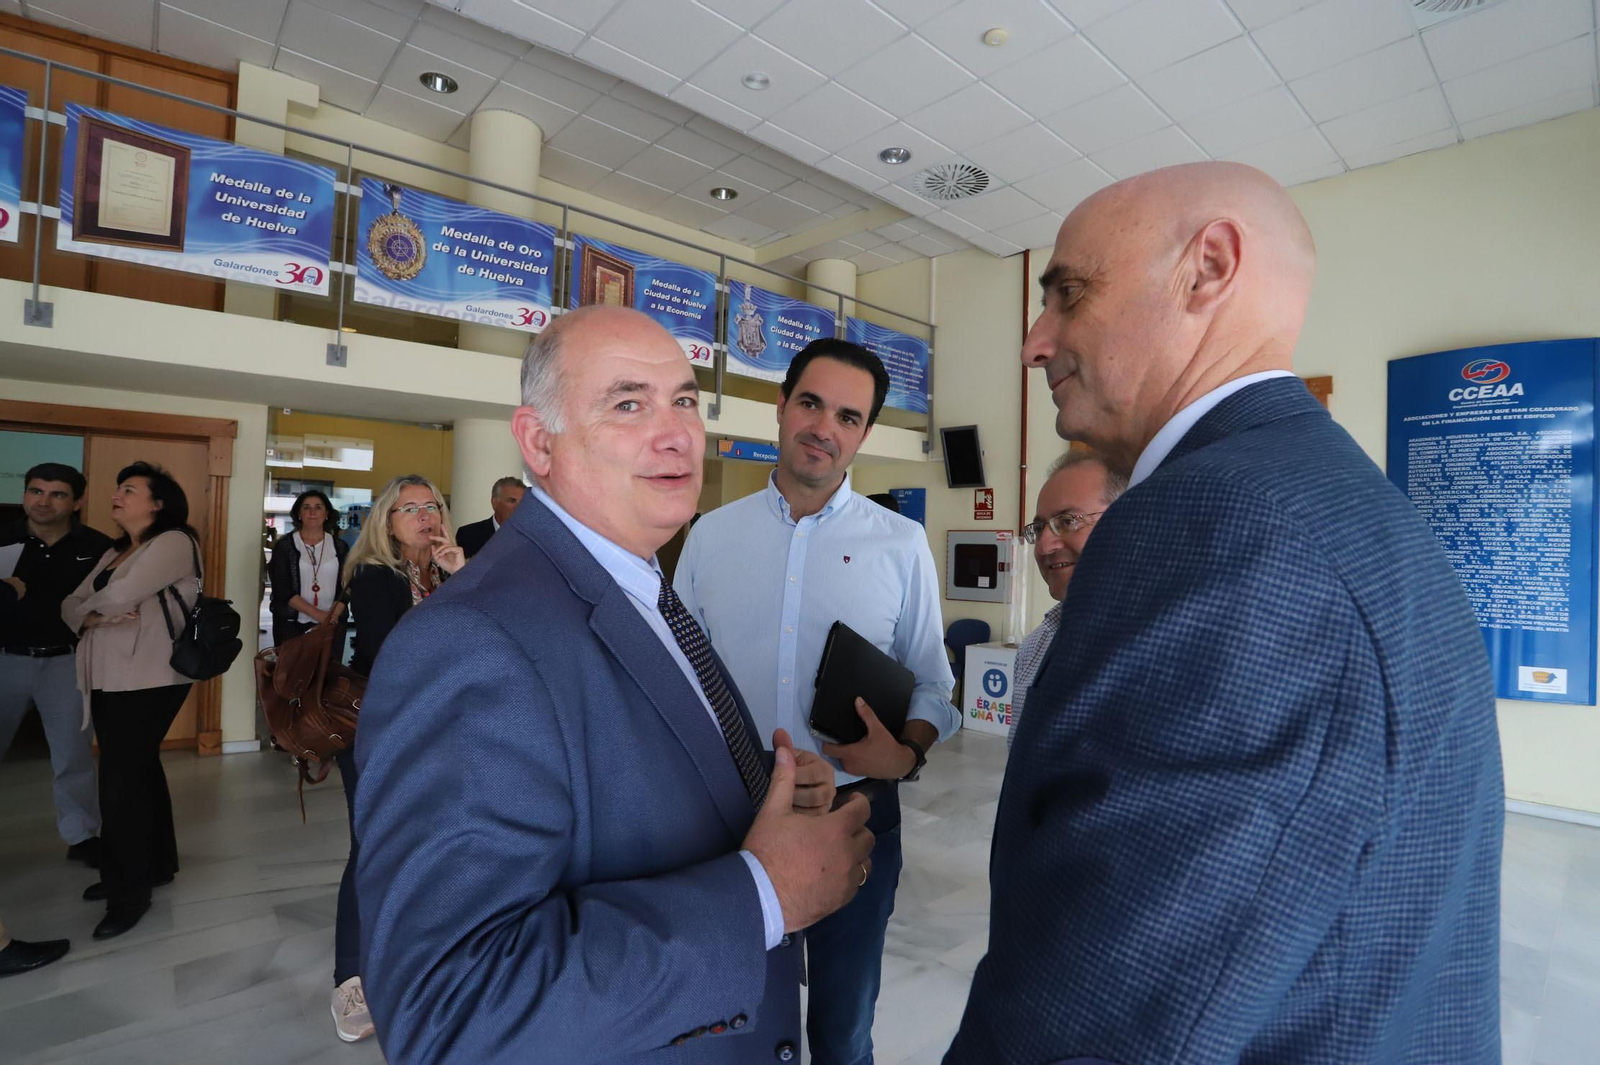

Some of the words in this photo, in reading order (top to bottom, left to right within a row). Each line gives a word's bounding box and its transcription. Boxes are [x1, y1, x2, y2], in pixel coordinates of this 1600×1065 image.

[210, 172, 272, 194] Medalla
[275, 188, 294, 200] de
[298, 192, 312, 204] la
[215, 192, 306, 219] Universidad
[222, 212, 241, 224] de
[245, 216, 298, 235] Huelva
[440, 226, 496, 247] Medalla
[498, 241, 515, 252] de
[519, 244, 542, 258] Oro
[432, 242, 450, 253] de
[454, 246, 468, 257] la
[471, 249, 548, 276] Universidad
[214, 258, 278, 277] Galardones
[276, 262, 324, 286] 30
[458, 264, 476, 275] de
[478, 268, 524, 286] Huelva
[652, 278, 681, 292] Medalla
[682, 287, 692, 295] de
[693, 289, 700, 297] la
[644, 288, 670, 300] Ciudad
[682, 298, 707, 310] Huelva
[466, 304, 514, 320] Galardones
[511, 308, 546, 326] 30
[666, 305, 702, 320] Economía
[770, 326, 794, 338] Ciudad
[778, 316, 804, 329] Medalla
[804, 324, 812, 332] de
[814, 326, 820, 334] la
[688, 344, 710, 361] 30
[1448, 382, 1524, 402] CCEAA
[1404, 413, 1448, 421] ASOCIACIONES
[1456, 408, 1493, 417] EMPRESAS
[753, 452, 778, 460] Recepción
[977, 696, 1012, 714] ÉRASE
[970, 708, 994, 722] ÜNA
[998, 713, 1012, 725] VE
